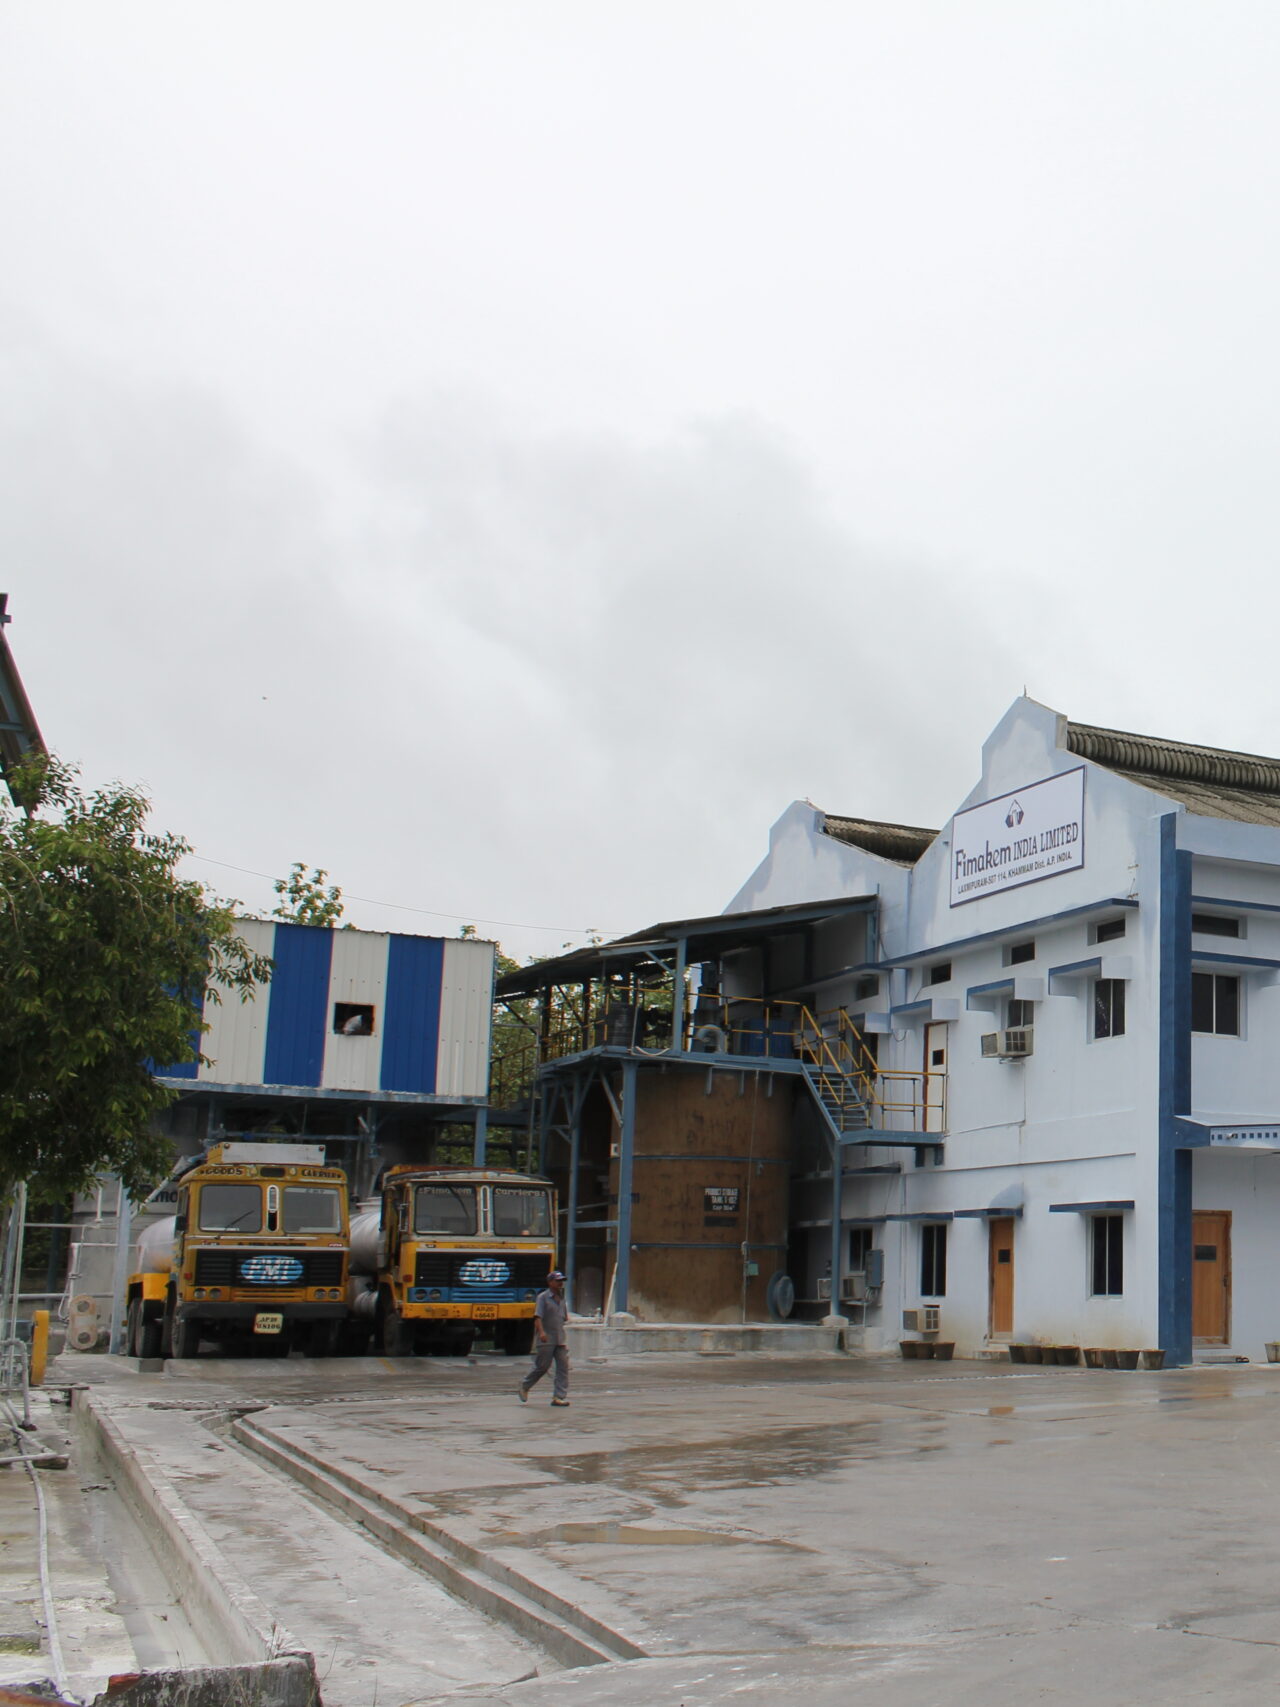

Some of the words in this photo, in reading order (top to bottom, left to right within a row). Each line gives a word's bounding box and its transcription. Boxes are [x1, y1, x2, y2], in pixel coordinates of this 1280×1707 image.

[955, 840, 1011, 880] Fimakem
[1013, 835, 1038, 861] INDIA
[1040, 822, 1079, 851] LIMITED
[423, 1187, 472, 1195] Fimaem
